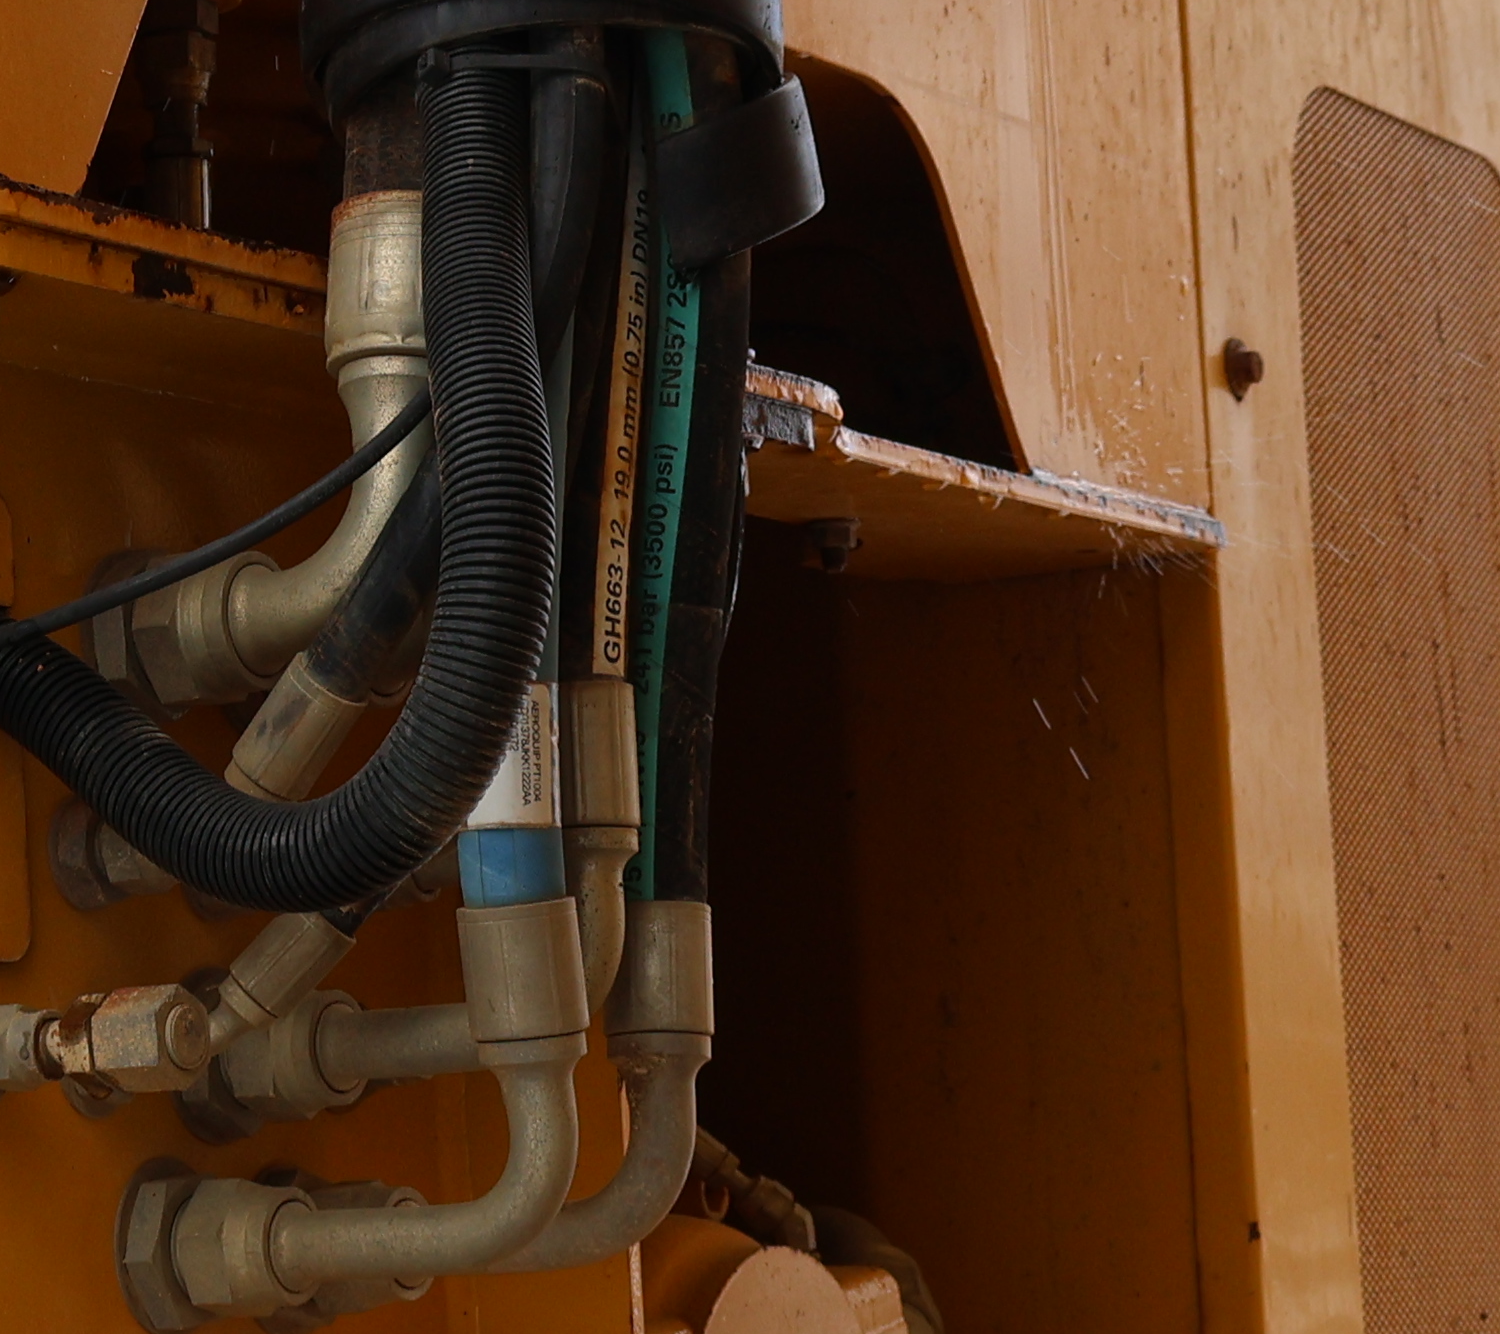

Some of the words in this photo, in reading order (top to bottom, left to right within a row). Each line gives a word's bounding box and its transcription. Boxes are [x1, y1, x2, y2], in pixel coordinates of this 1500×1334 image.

[629, 270, 648, 304] in)
[659, 319, 686, 408] EN857
[622, 386, 641, 440] mm
[654, 443, 679, 495] psi)
[641, 503, 668, 580] (3500
[604, 520, 627, 664] GH663-12
[531, 700, 541, 761] AEROQUIP
[533, 761, 542, 802] PT1004
